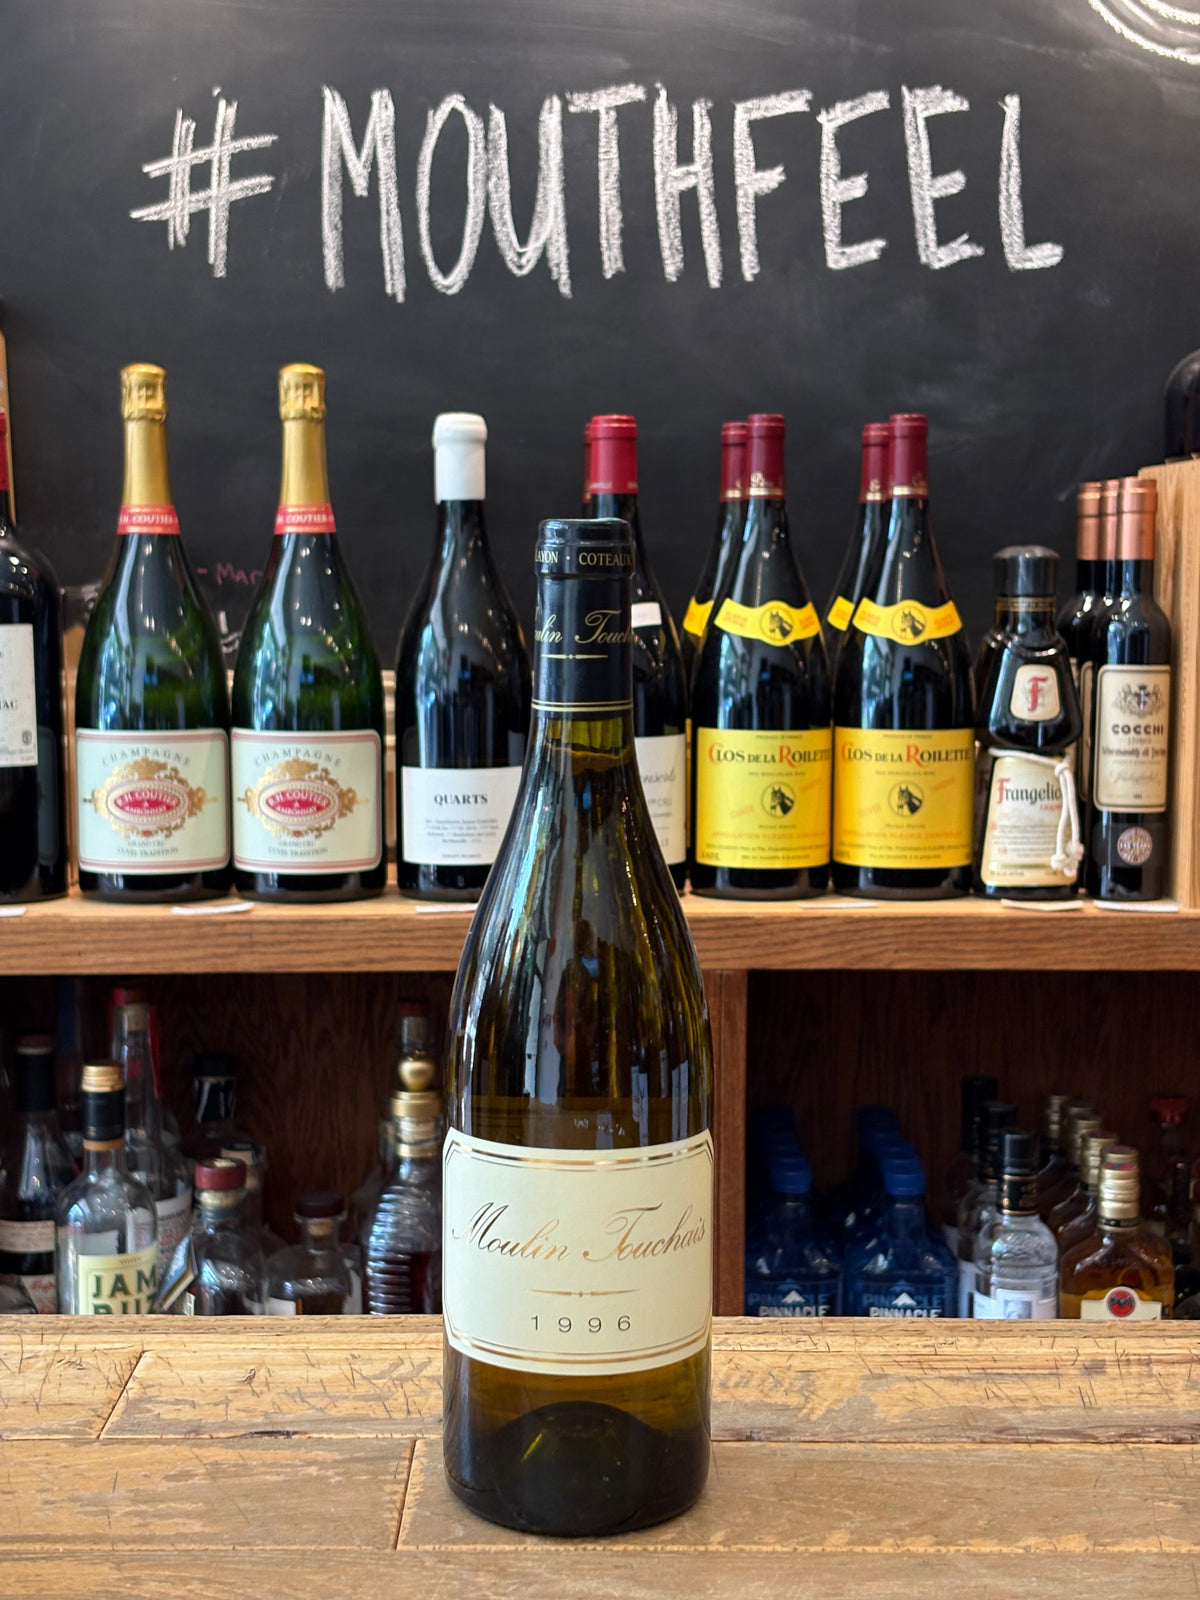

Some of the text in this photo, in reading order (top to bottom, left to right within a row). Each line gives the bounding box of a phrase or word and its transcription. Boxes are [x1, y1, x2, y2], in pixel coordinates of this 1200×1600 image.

[578, 552, 632, 566] COTEAUX
[1111, 724, 1164, 735] COCCHI
[102, 747, 191, 767] CHAMPAGNE
[255, 747, 343, 768] CHAMPAGNE
[709, 743, 745, 764] CLOS
[434, 793, 488, 806] QUARTS
[997, 777, 1062, 805] Frangelic
[452, 1202, 706, 1262] Moulin Touchais
[530, 1314, 632, 1333] 1996
